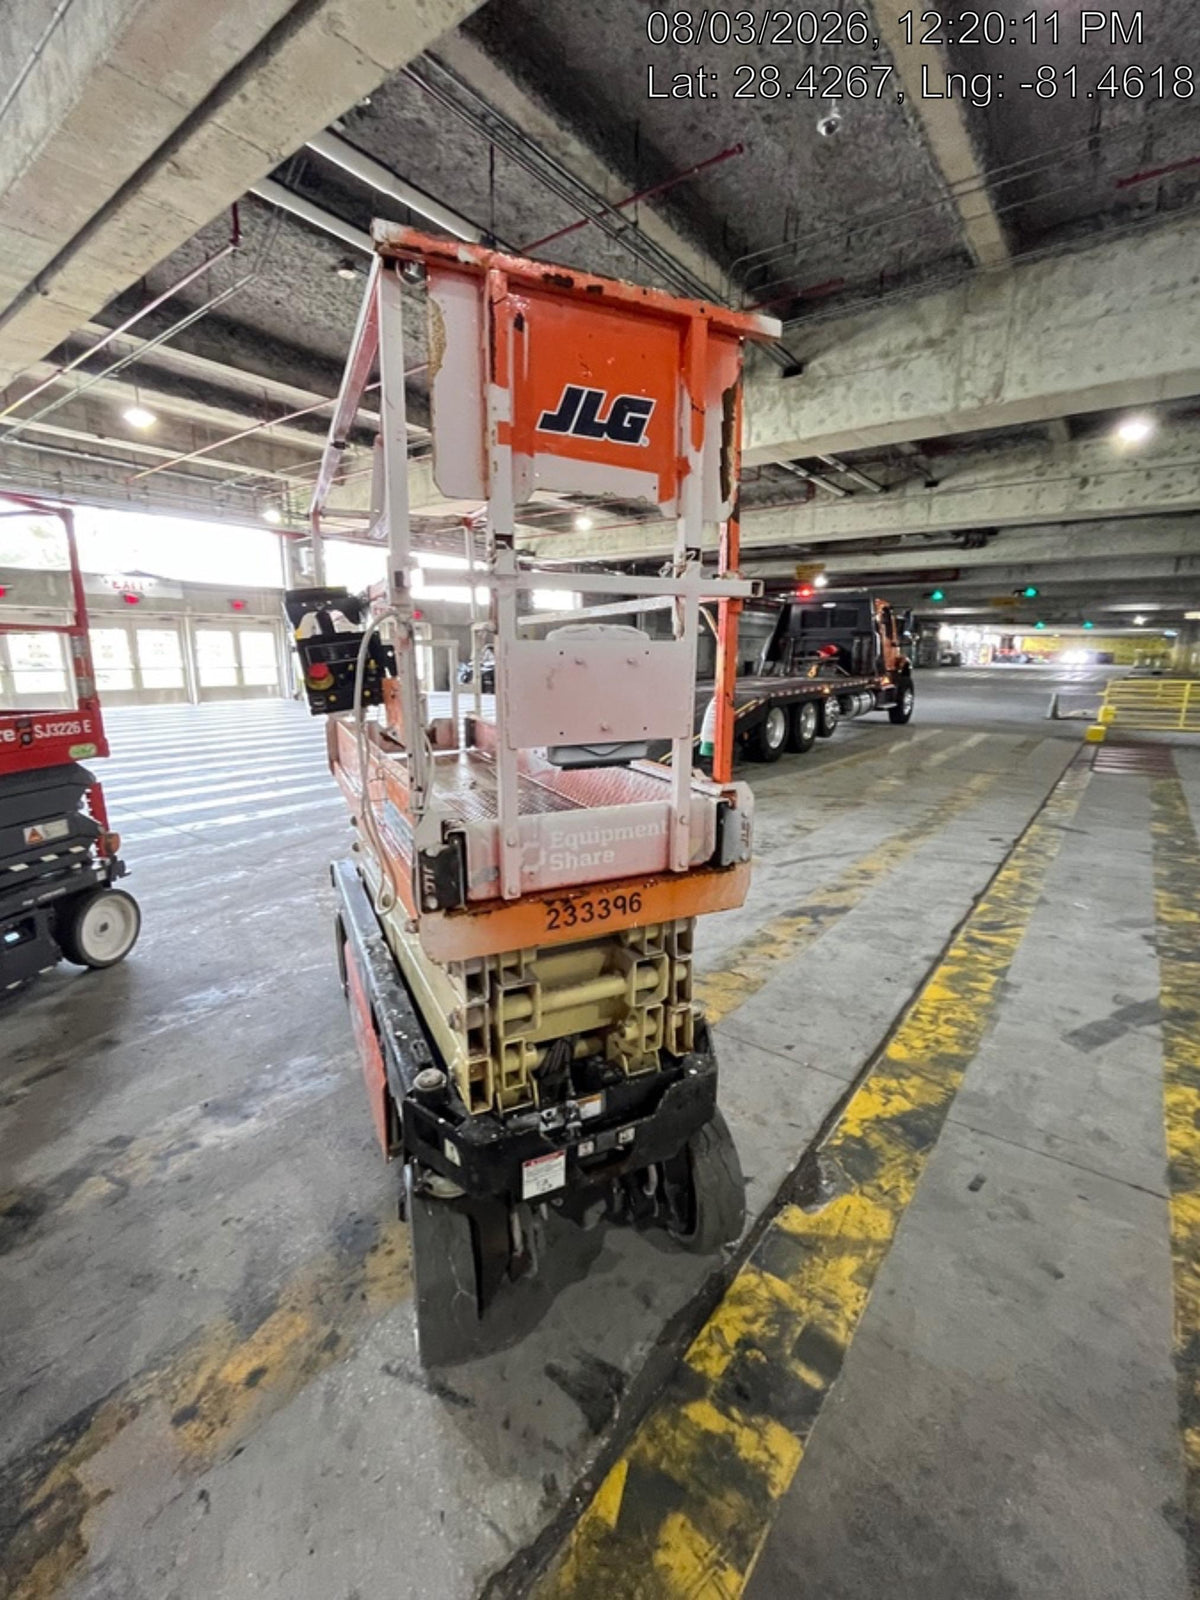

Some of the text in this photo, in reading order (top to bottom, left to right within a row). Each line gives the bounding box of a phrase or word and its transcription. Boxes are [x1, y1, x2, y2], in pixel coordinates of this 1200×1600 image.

[536, 384, 657, 446] JLG
[551, 819, 669, 849] Equipment
[550, 849, 616, 872] Share
[546, 892, 642, 931] 233396
